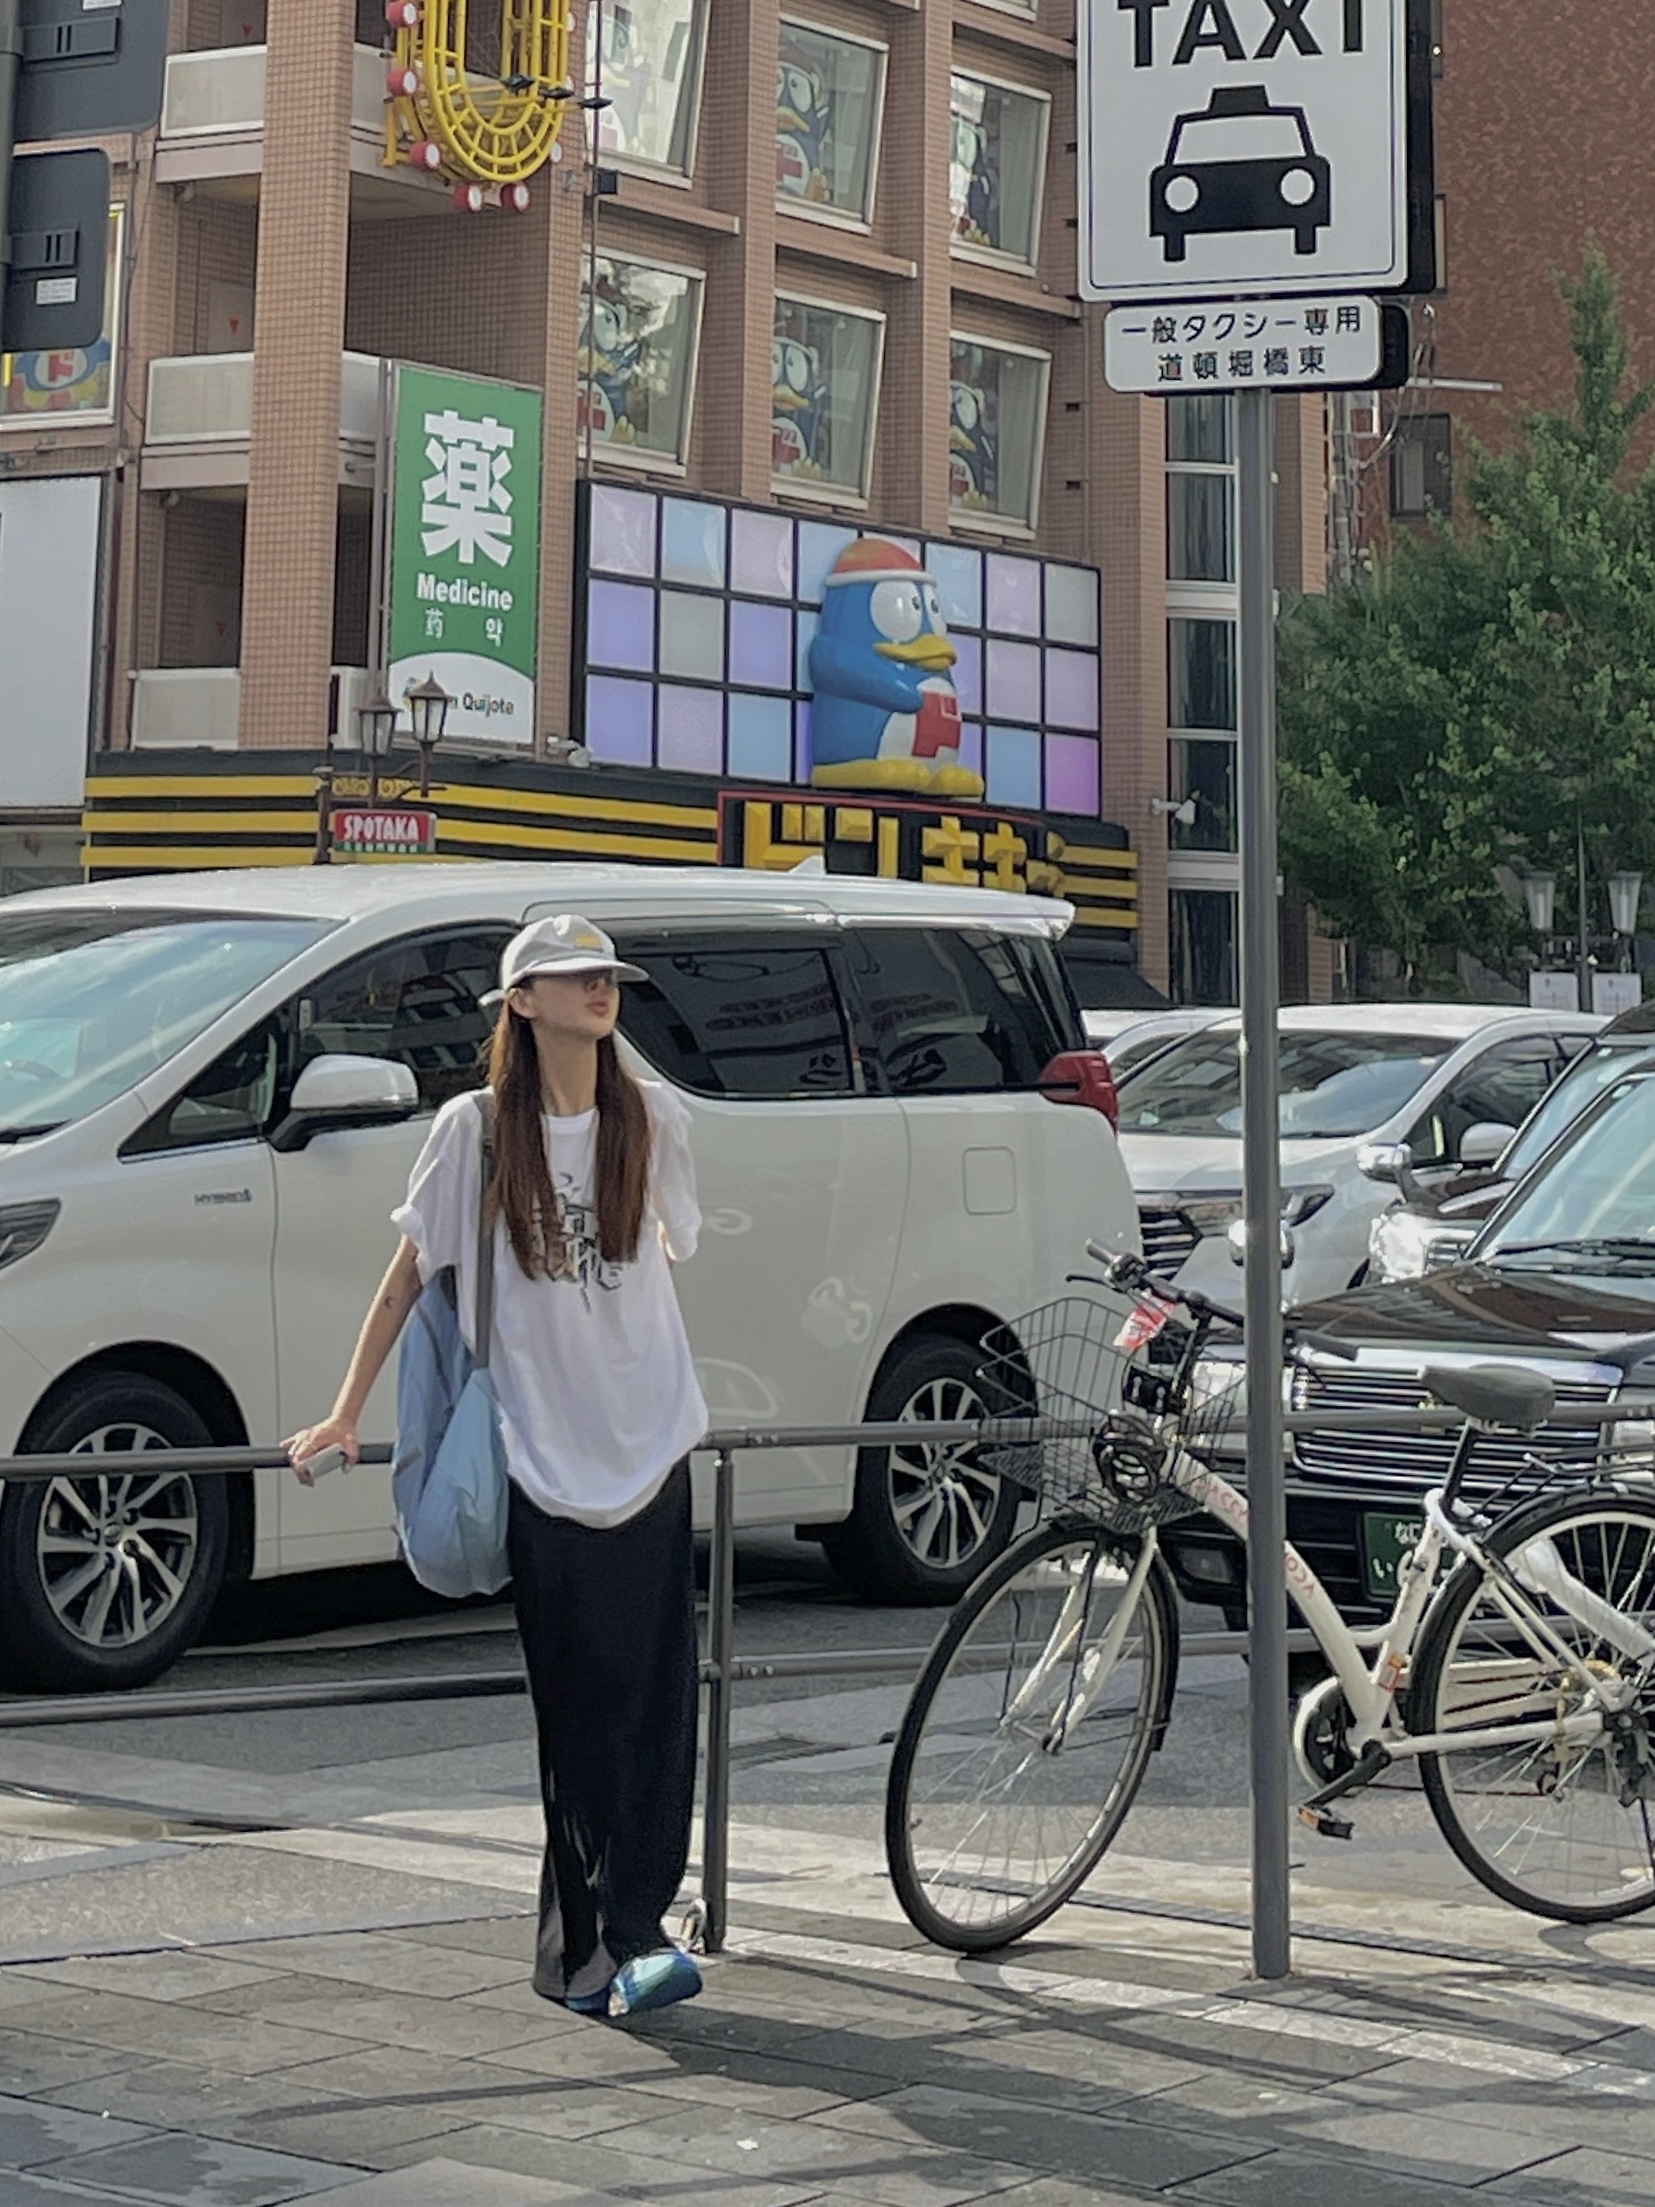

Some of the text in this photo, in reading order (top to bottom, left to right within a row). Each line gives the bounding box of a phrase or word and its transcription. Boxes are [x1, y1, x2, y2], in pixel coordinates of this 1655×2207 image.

[1117, 0, 1364, 67] TAXI
[1121, 305, 1362, 344] 一般タクシー専用
[1157, 345, 1326, 382] 道頓堀橋東
[421, 409, 514, 568] 薬
[417, 572, 514, 611] Medicine
[463, 691, 514, 717] Quijote
[343, 814, 420, 841] SPOTAKA
